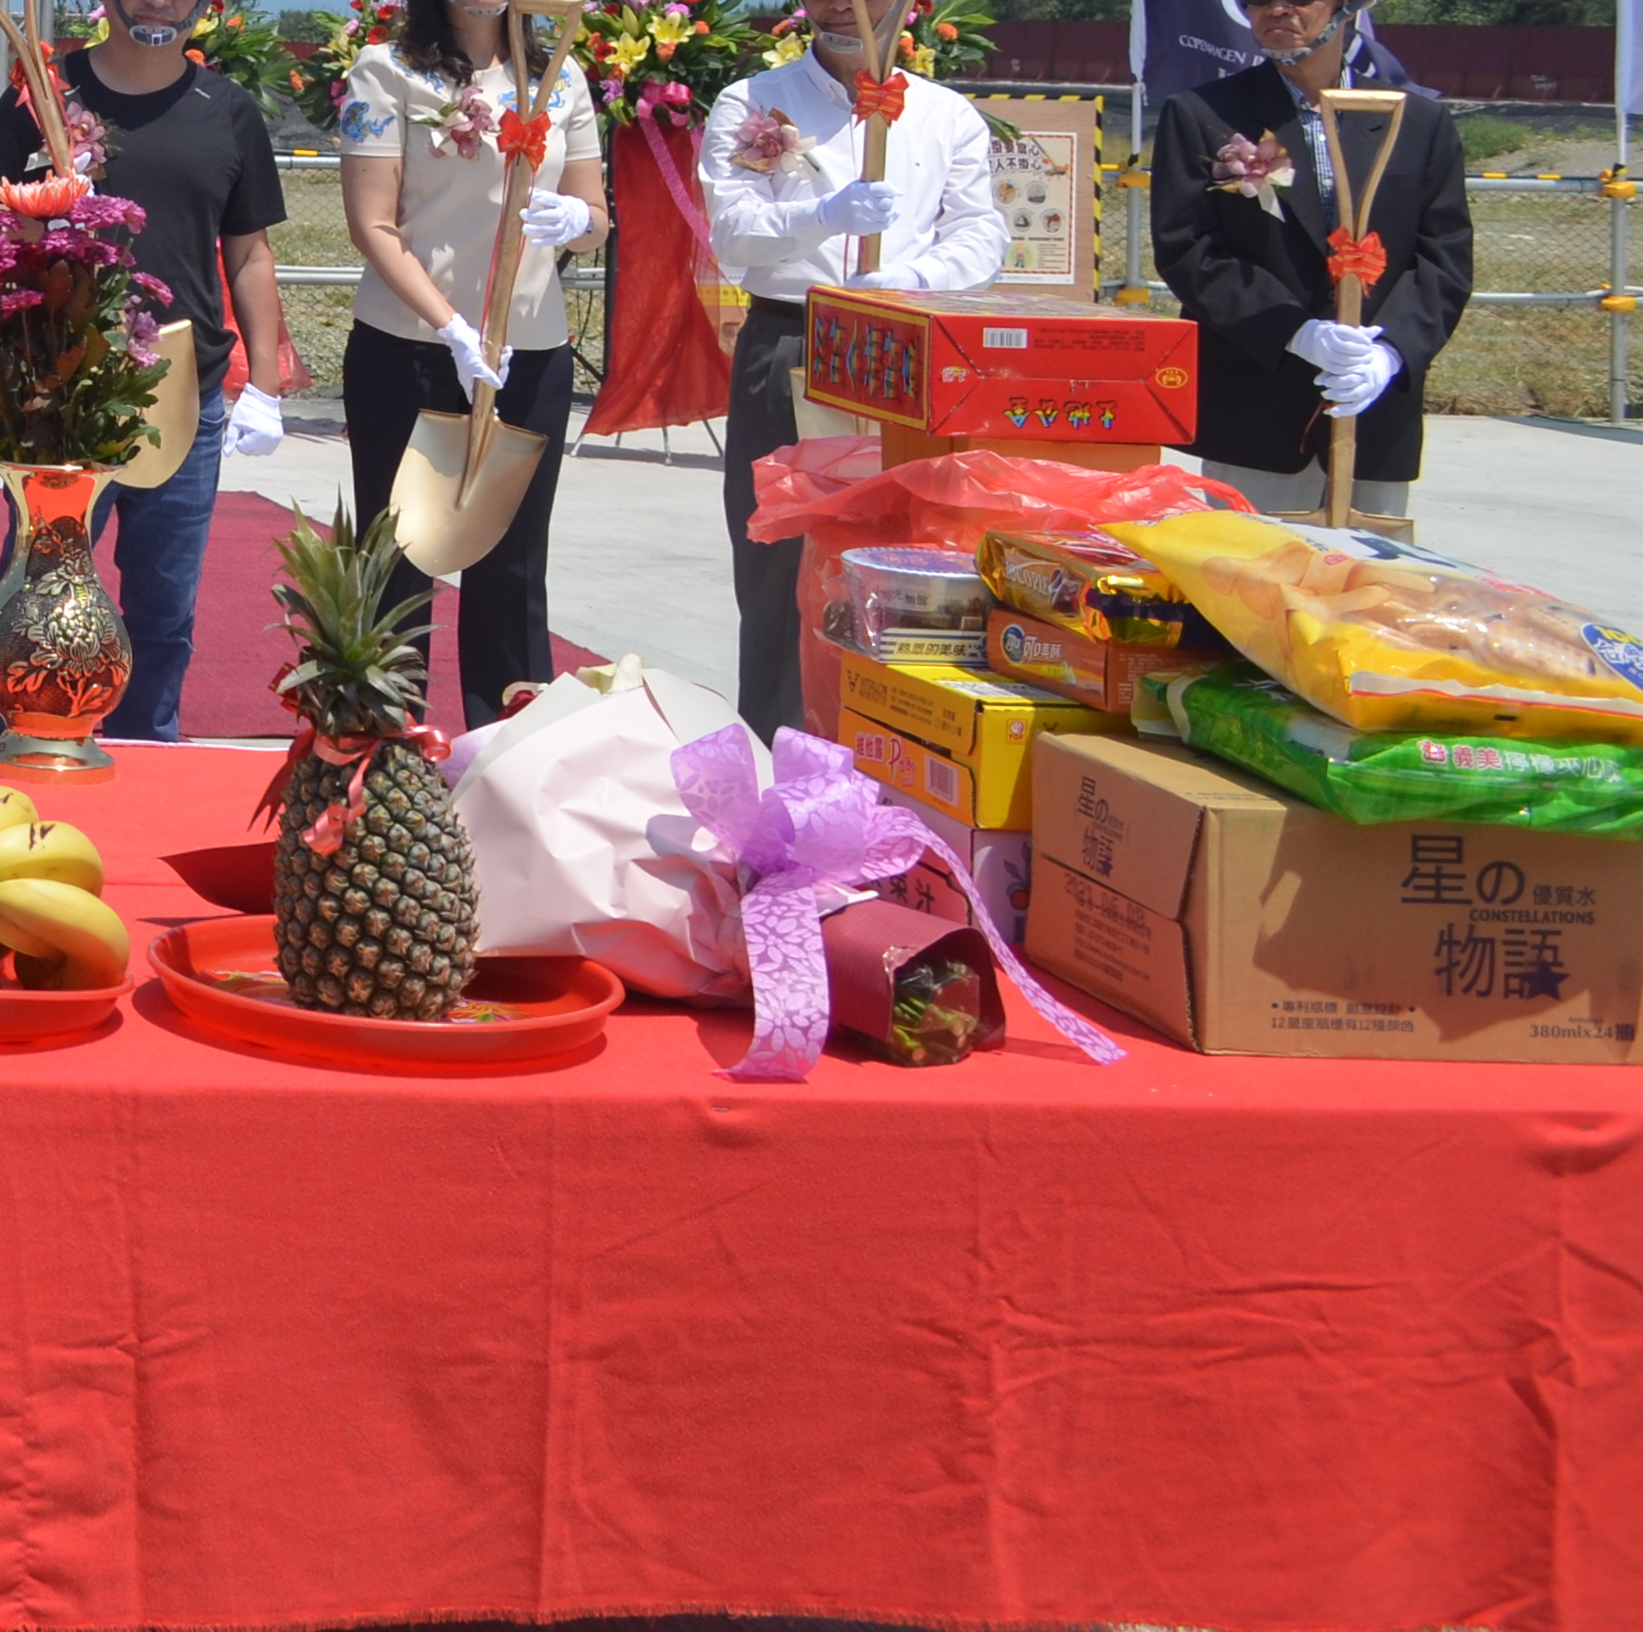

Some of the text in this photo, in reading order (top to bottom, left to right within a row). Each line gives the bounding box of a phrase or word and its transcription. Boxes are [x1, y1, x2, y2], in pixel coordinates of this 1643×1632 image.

[1451, 744, 1503, 771] 義美
[1400, 833, 1526, 906] 星の
[1532, 884, 1597, 907] 優質水
[1468, 908, 1596, 925] CONSTELLATIONS
[1433, 922, 1565, 1001] 物語
